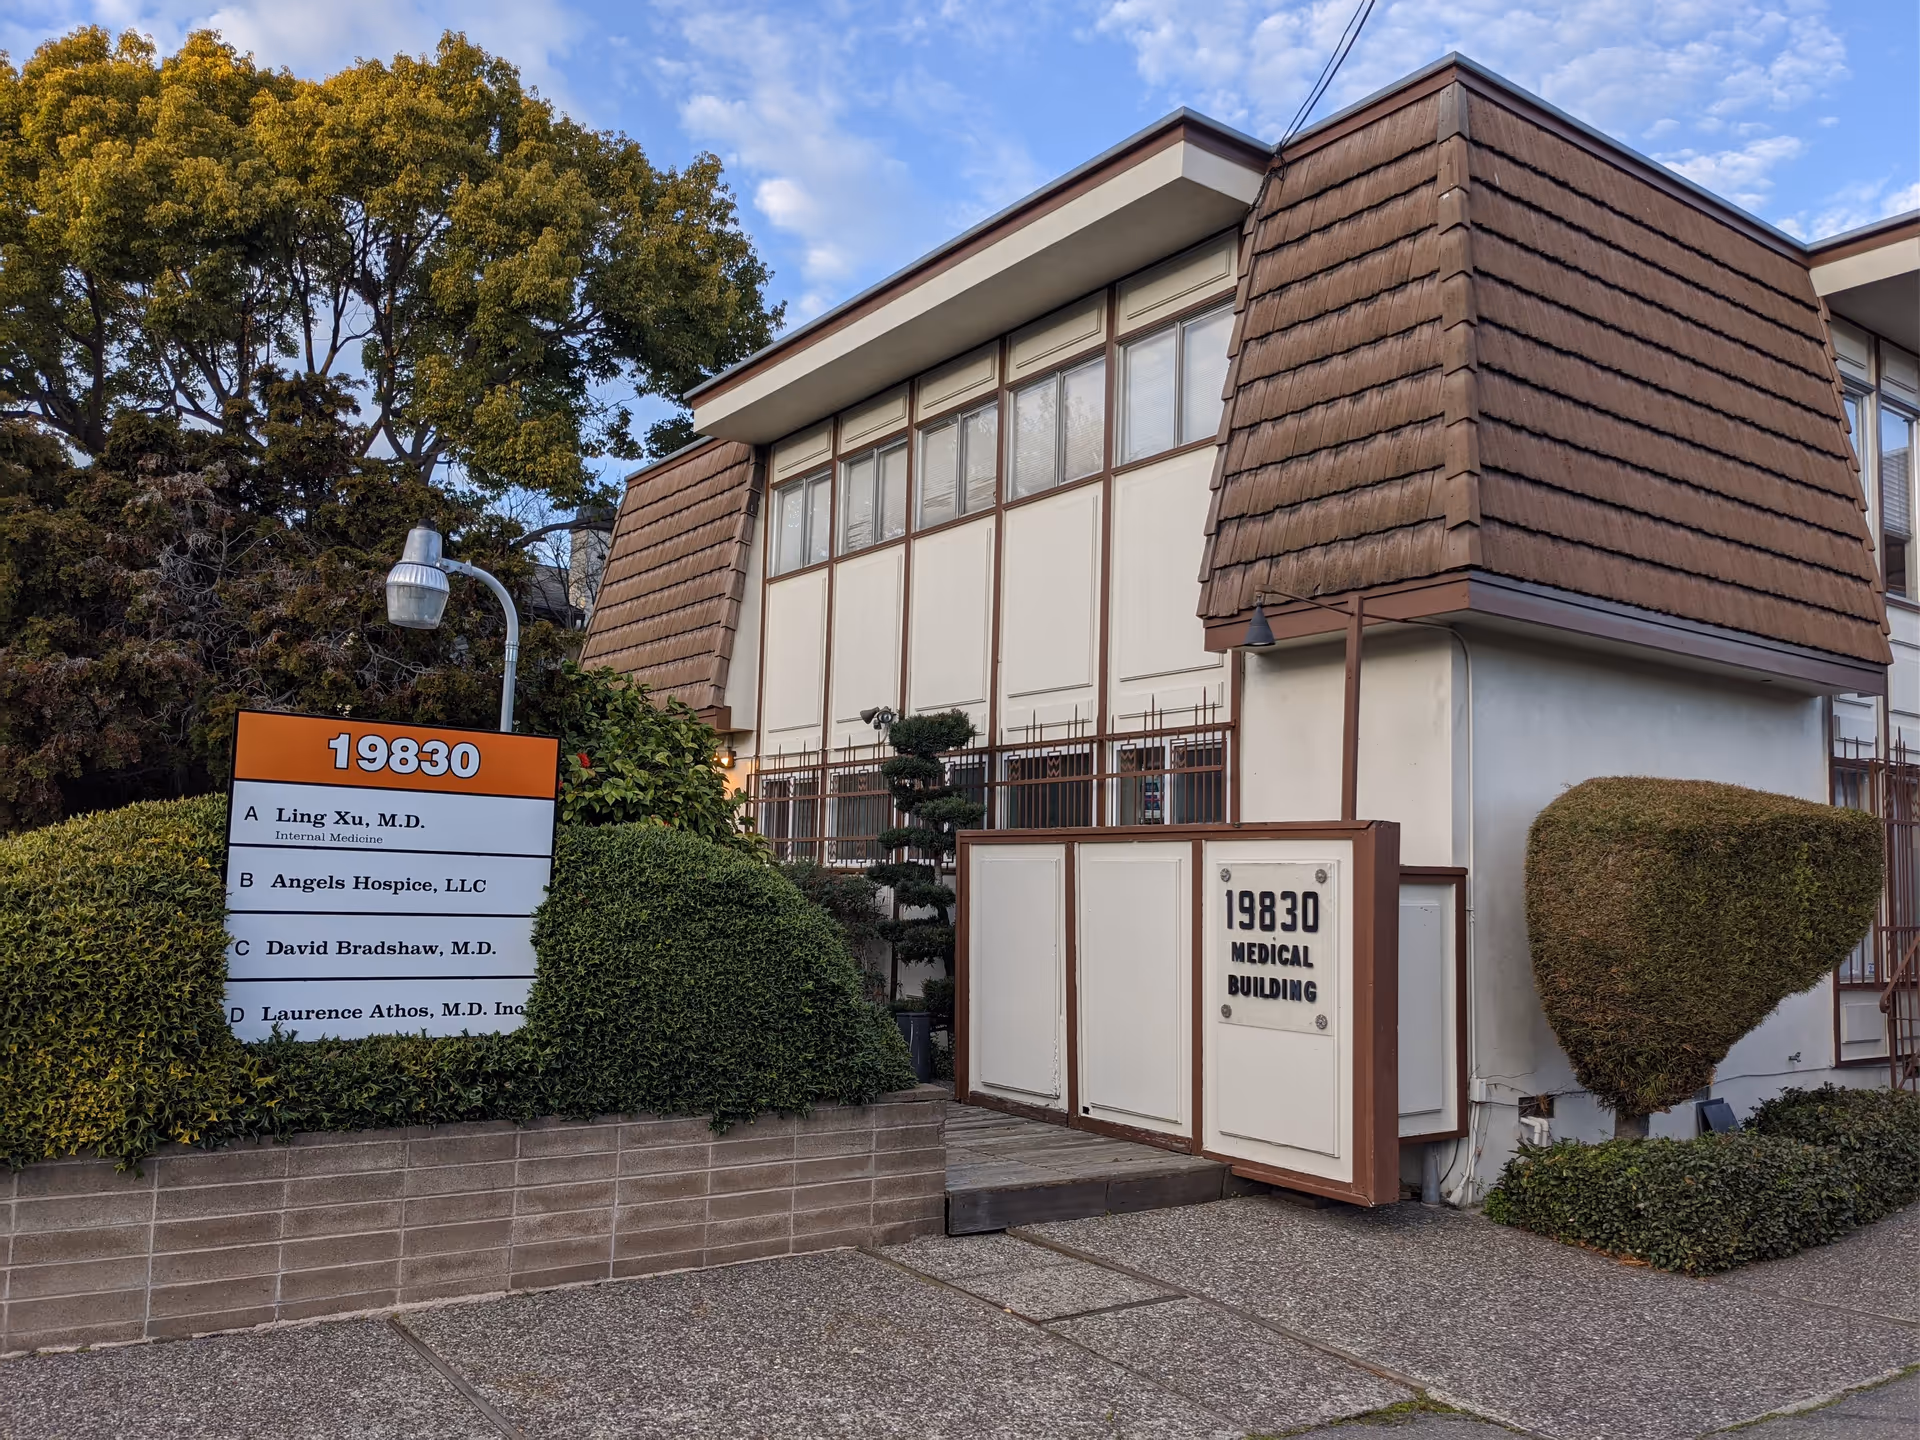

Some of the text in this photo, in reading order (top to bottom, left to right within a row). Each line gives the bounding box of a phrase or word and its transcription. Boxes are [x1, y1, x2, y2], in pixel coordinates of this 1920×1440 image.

[328, 733, 480, 778] 19830
[244, 806, 425, 829] A Ling Xu, M.D.
[275, 831, 383, 844] Internal Medicine
[240, 872, 487, 895] B Angels Hospice, LLC
[1225, 889, 1320, 933] 19830
[234, 940, 498, 957] C David Bradshaw, M.D.
[1231, 941, 1314, 968] MEDICAL
[1228, 975, 1317, 1003] BUILDING
[231, 1007, 245, 1023] D
[262, 1006, 363, 1022] Laurence
[369, 1003, 434, 1019] Athos,
[442, 1002, 488, 1017] M.D.
